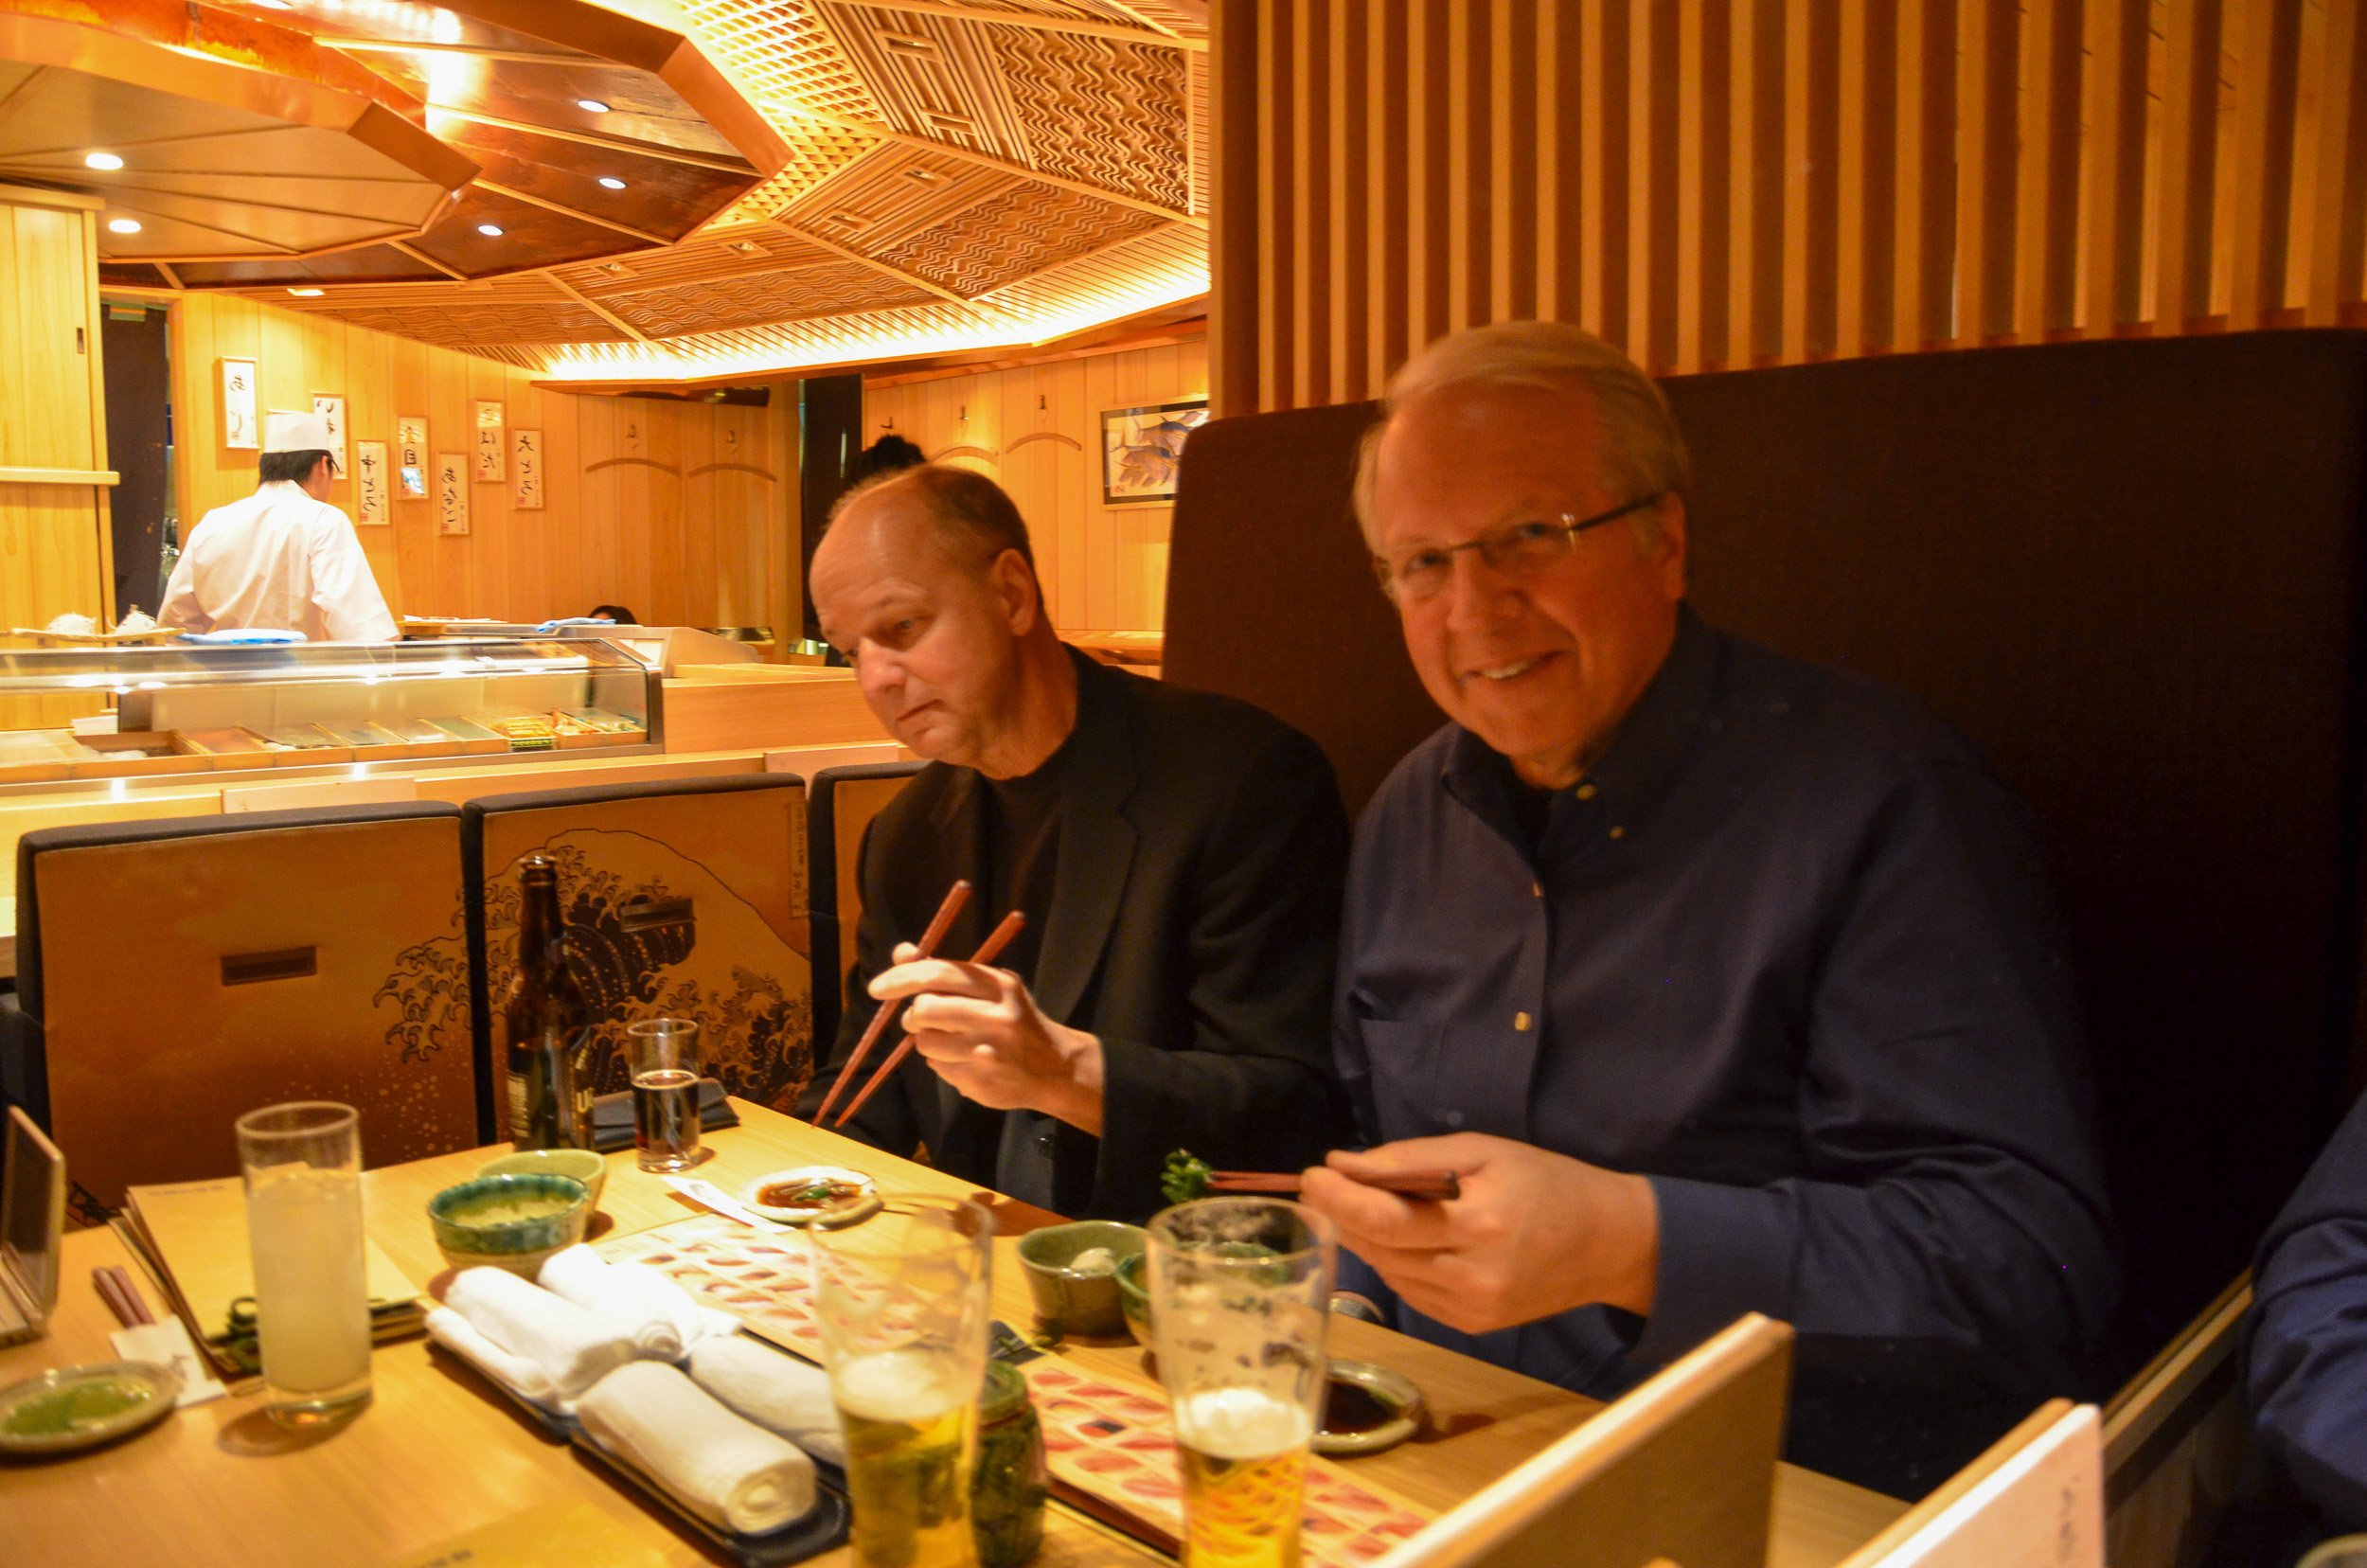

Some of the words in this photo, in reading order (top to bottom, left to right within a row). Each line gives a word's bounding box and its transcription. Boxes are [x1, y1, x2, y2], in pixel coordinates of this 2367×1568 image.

[361, 454, 377, 512] 中とろ
[517, 435, 535, 495] 大とろ
[441, 466, 458, 523] あなご
